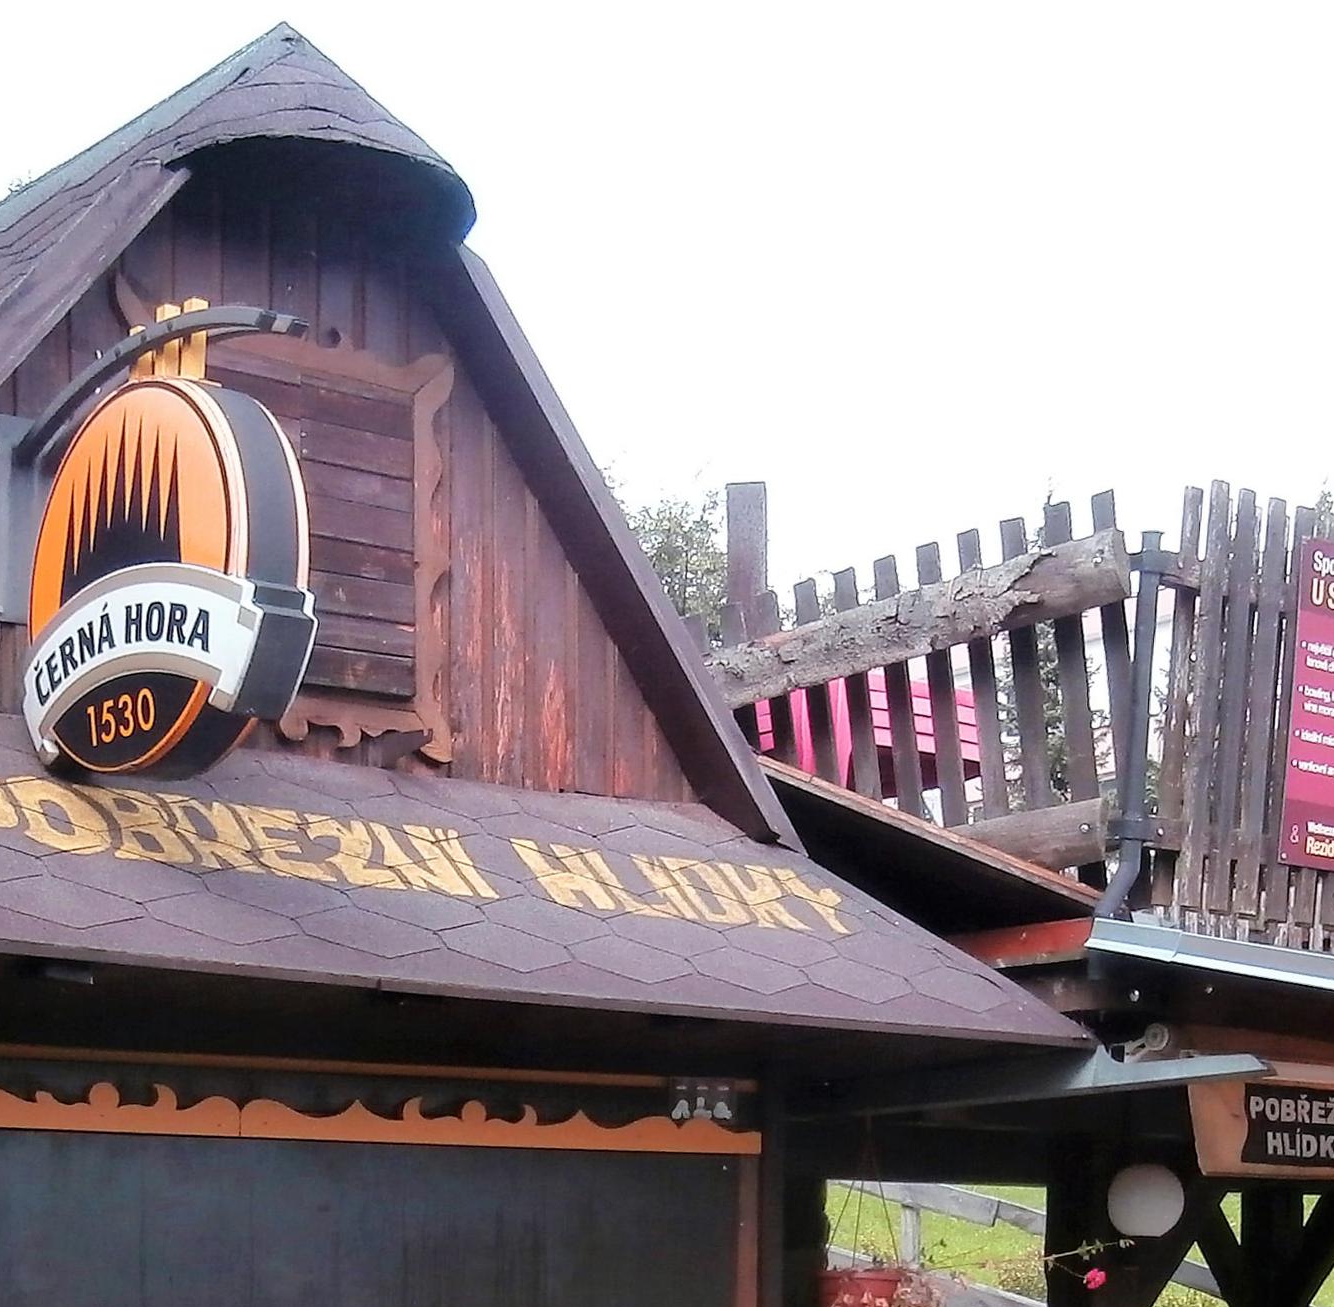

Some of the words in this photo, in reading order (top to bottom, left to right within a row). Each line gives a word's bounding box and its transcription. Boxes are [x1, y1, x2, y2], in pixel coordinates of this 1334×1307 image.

[1311, 578, 1325, 606] U
[34, 602, 116, 706] ČERNÁ
[125, 601, 211, 653] HORA
[86, 687, 157, 748] 1530
